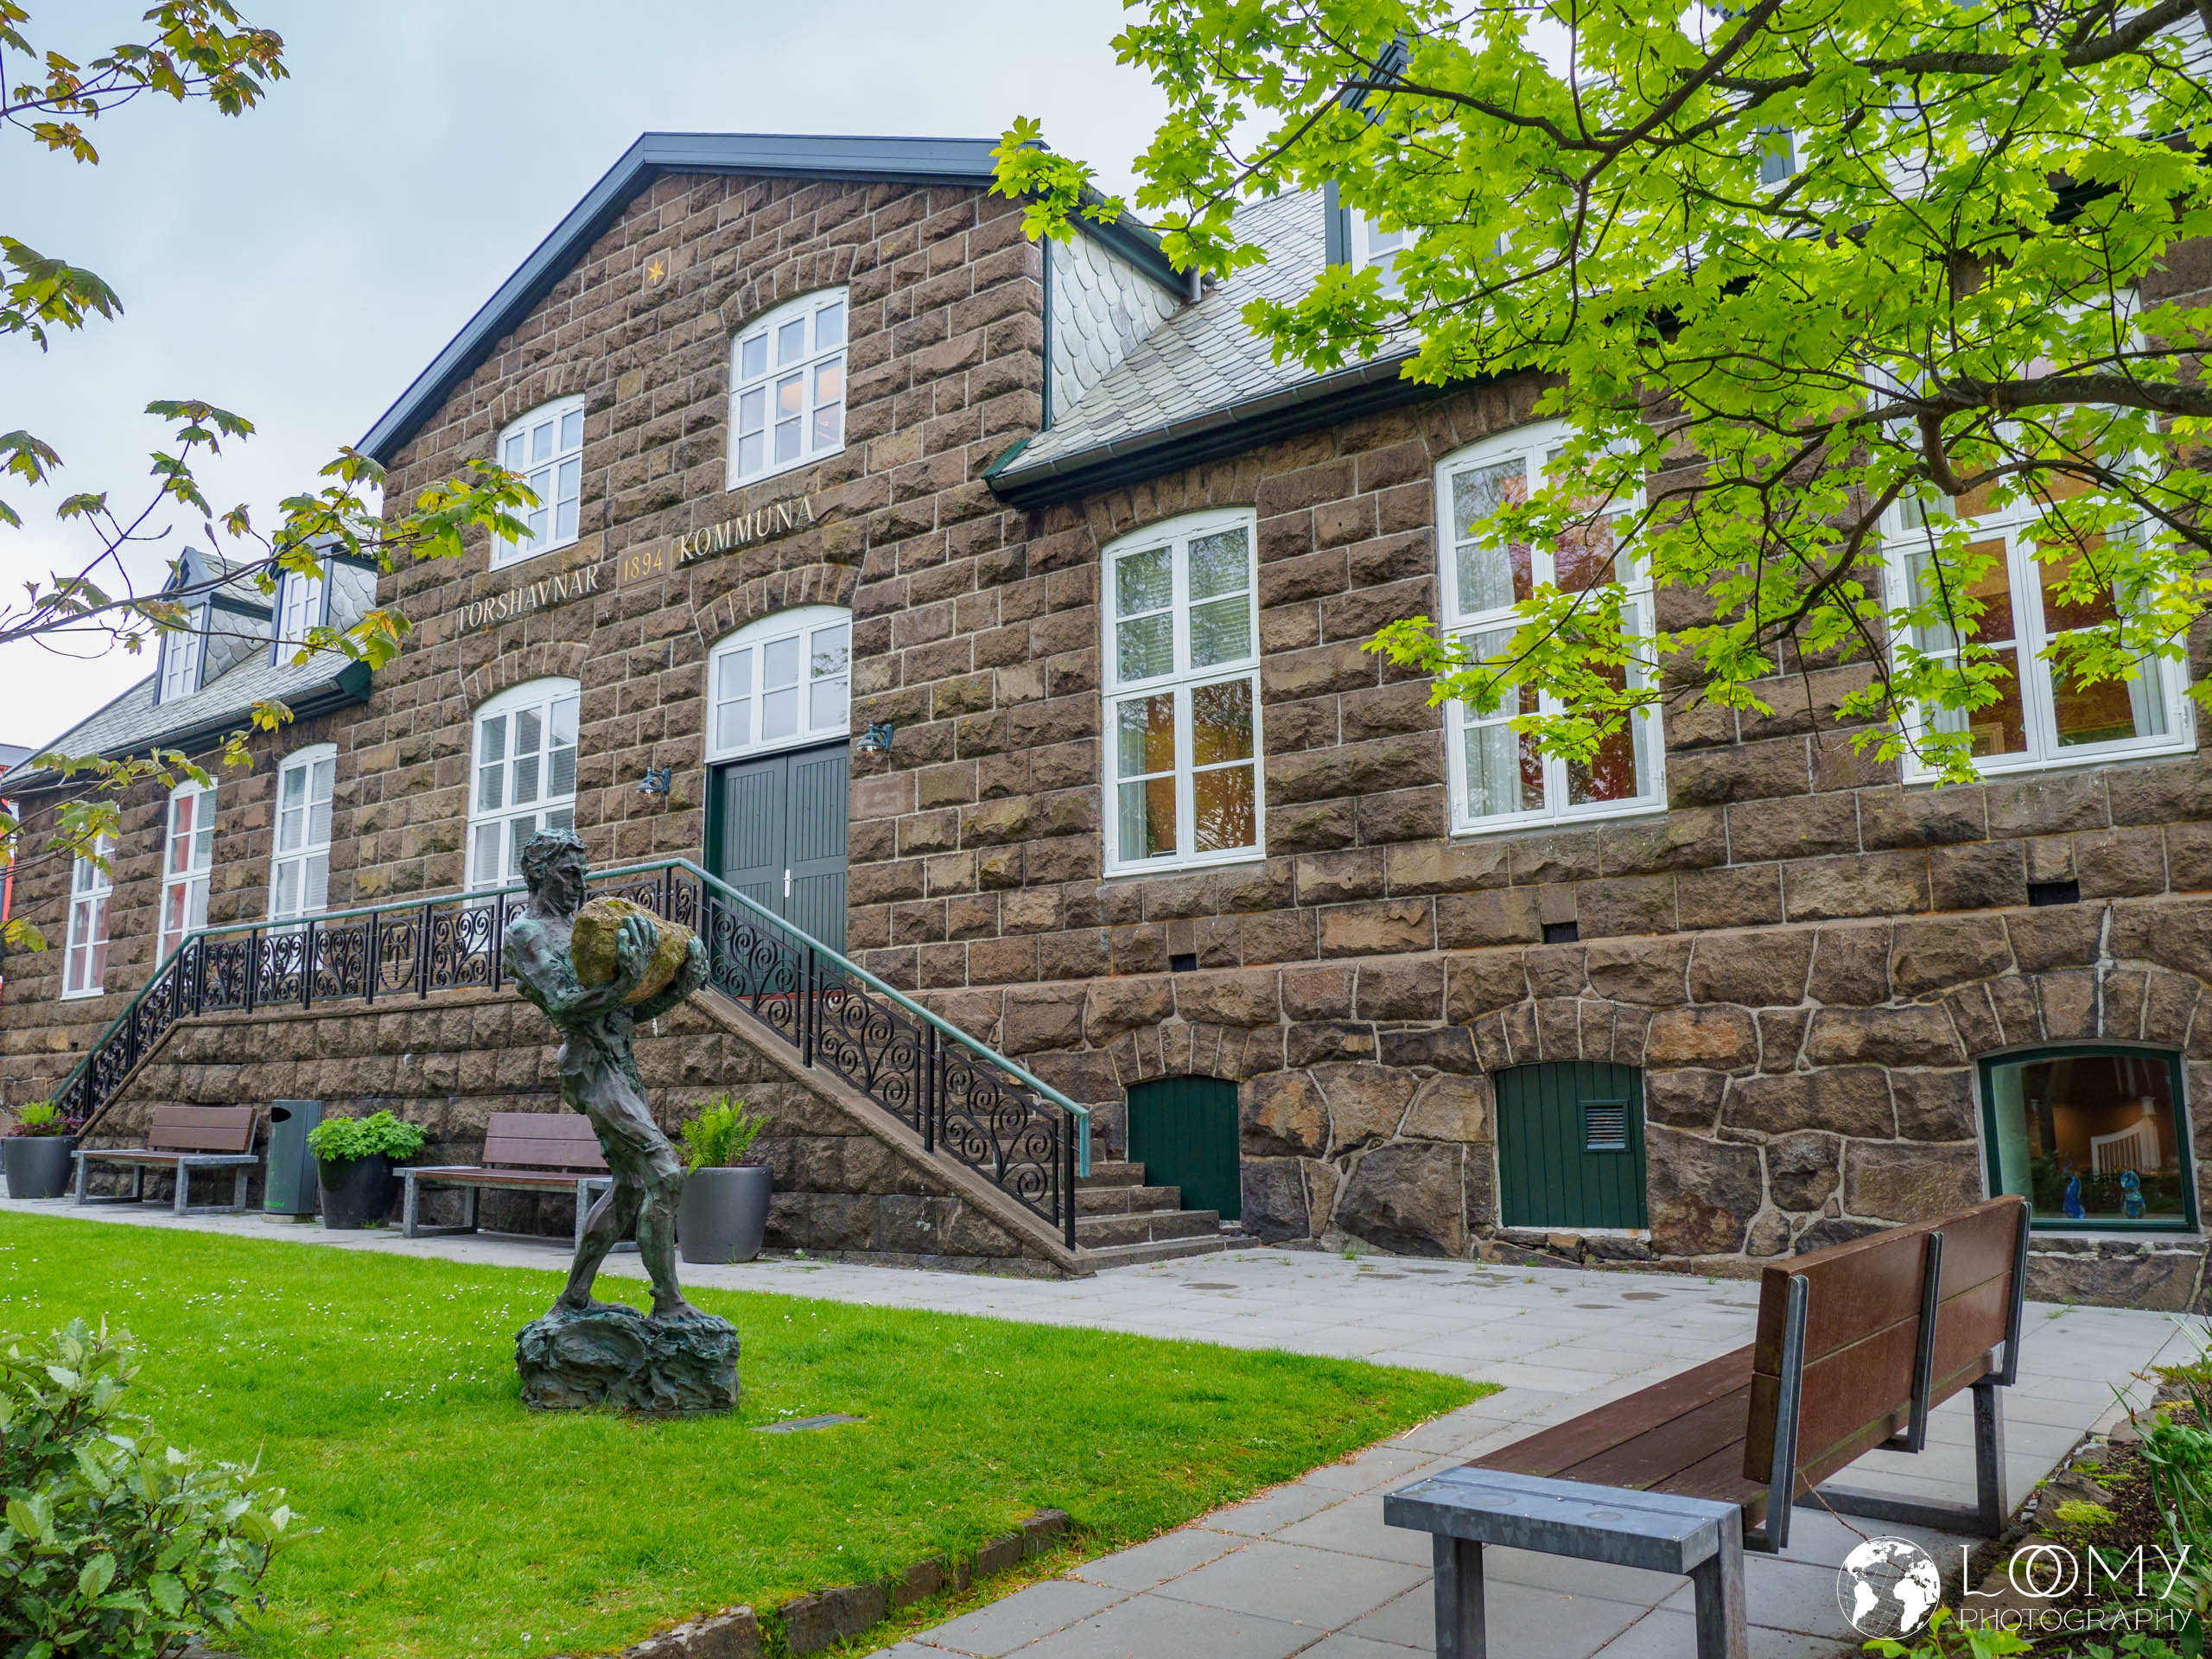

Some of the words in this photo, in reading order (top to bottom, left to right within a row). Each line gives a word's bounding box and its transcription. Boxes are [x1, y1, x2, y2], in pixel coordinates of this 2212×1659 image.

[457, 565, 600, 632] TORSHAVNAR
[624, 548, 664, 582] 1894
[679, 495, 816, 563] KOMMUNA
